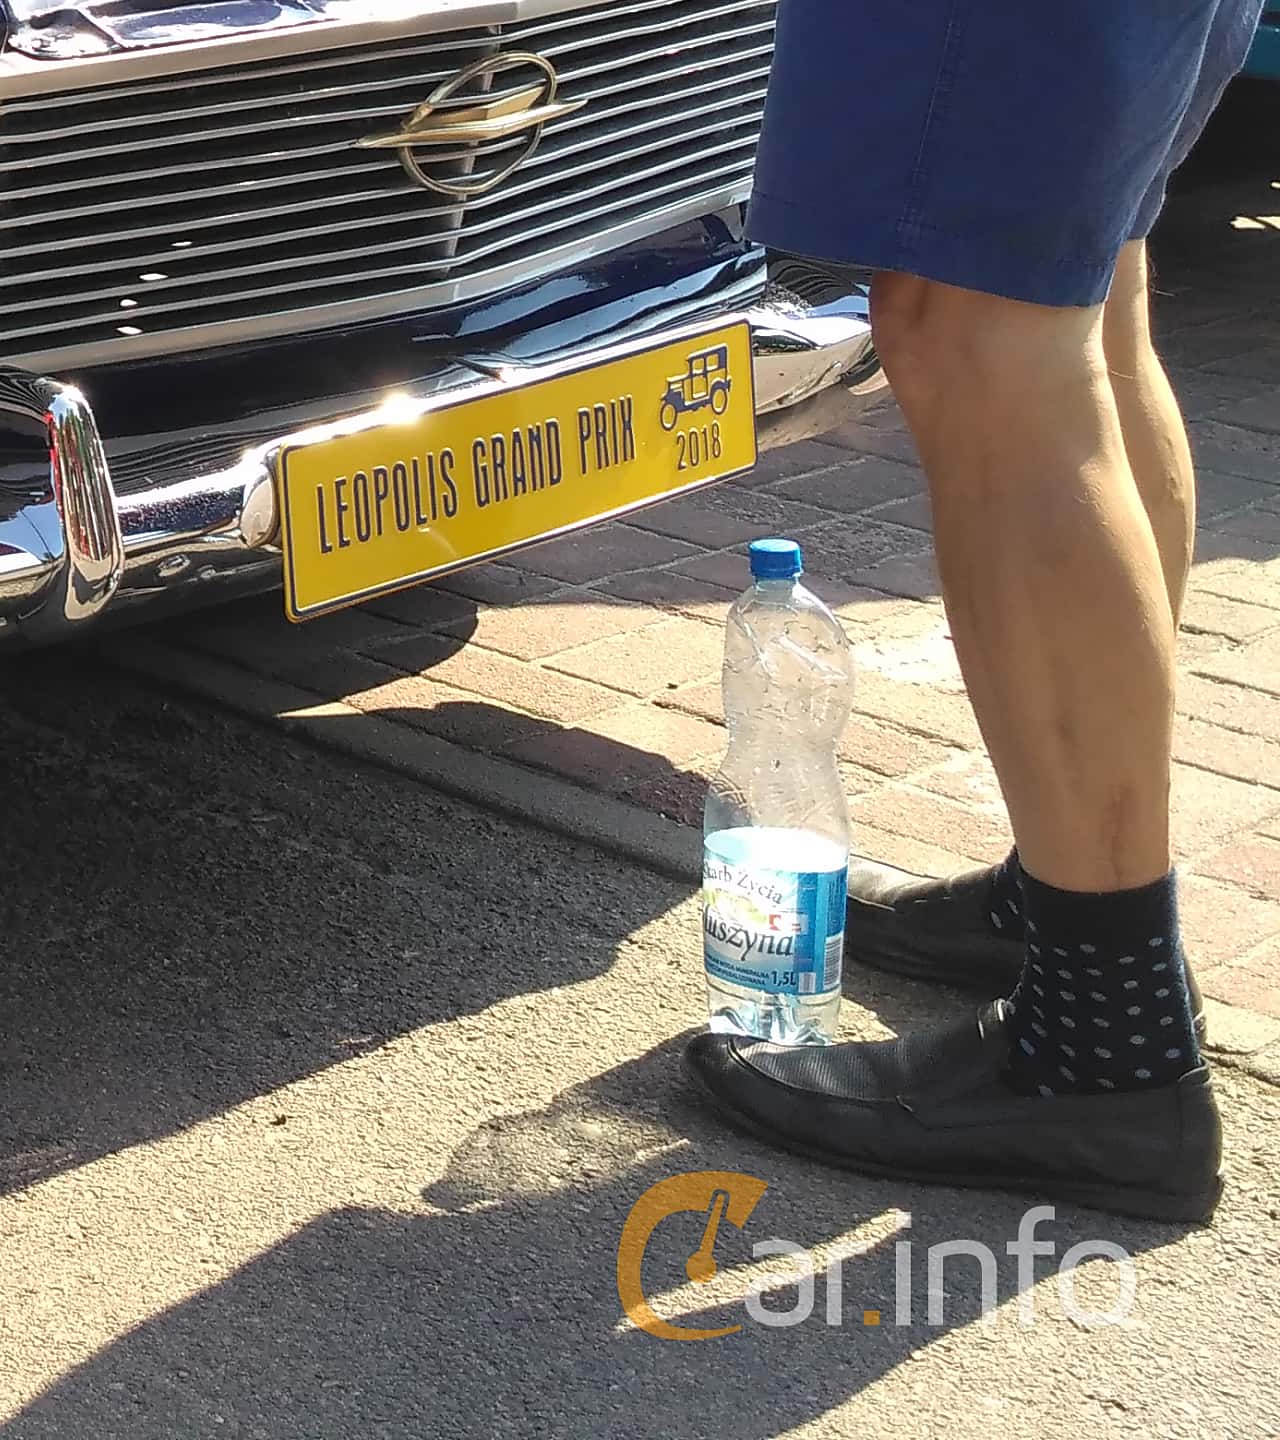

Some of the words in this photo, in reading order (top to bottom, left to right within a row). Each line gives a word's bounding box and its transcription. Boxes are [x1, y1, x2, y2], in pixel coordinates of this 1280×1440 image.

[315, 447, 458, 554] LEOPOLIS
[472, 417, 562, 509] GRAND
[578, 394, 636, 475] PRIX
[676, 419, 723, 472] 2018
